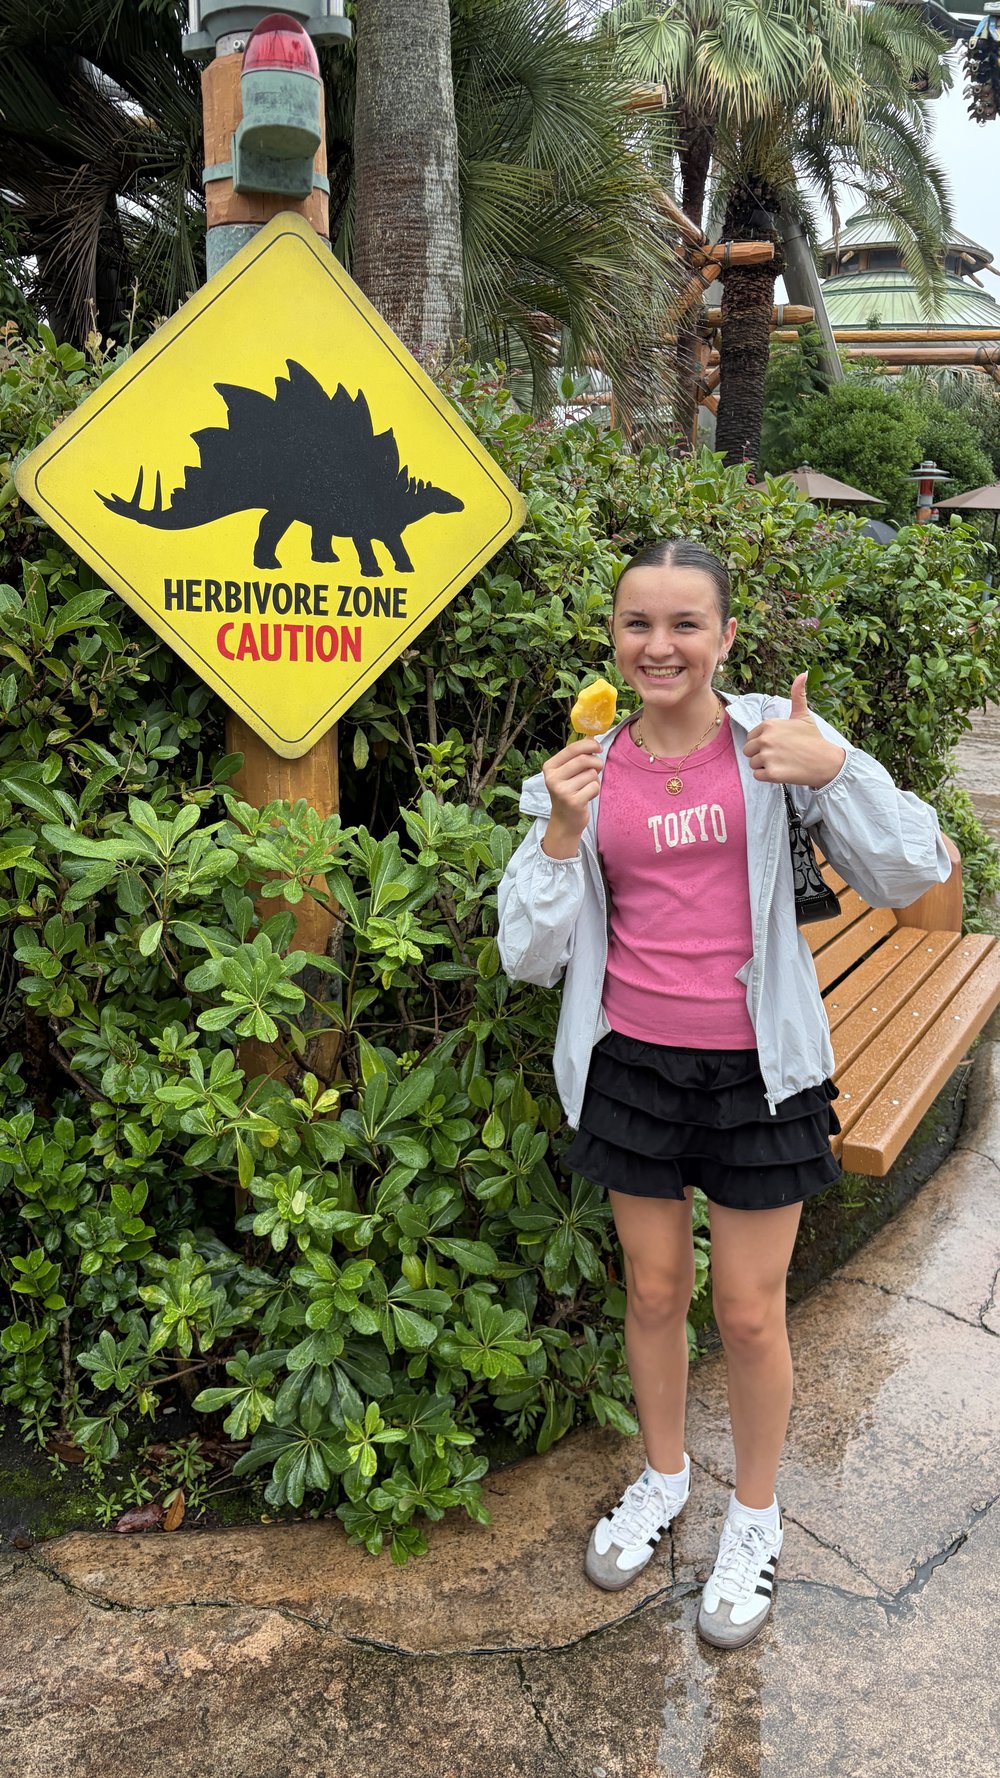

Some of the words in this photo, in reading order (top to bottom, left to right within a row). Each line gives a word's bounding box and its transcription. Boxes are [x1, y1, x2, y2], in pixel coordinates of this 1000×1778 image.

[163, 578, 329, 616] HERBIVORE
[336, 585, 408, 619] ZONE
[216, 622, 362, 663] CAUTION
[647, 803, 728, 854] TOKYO
